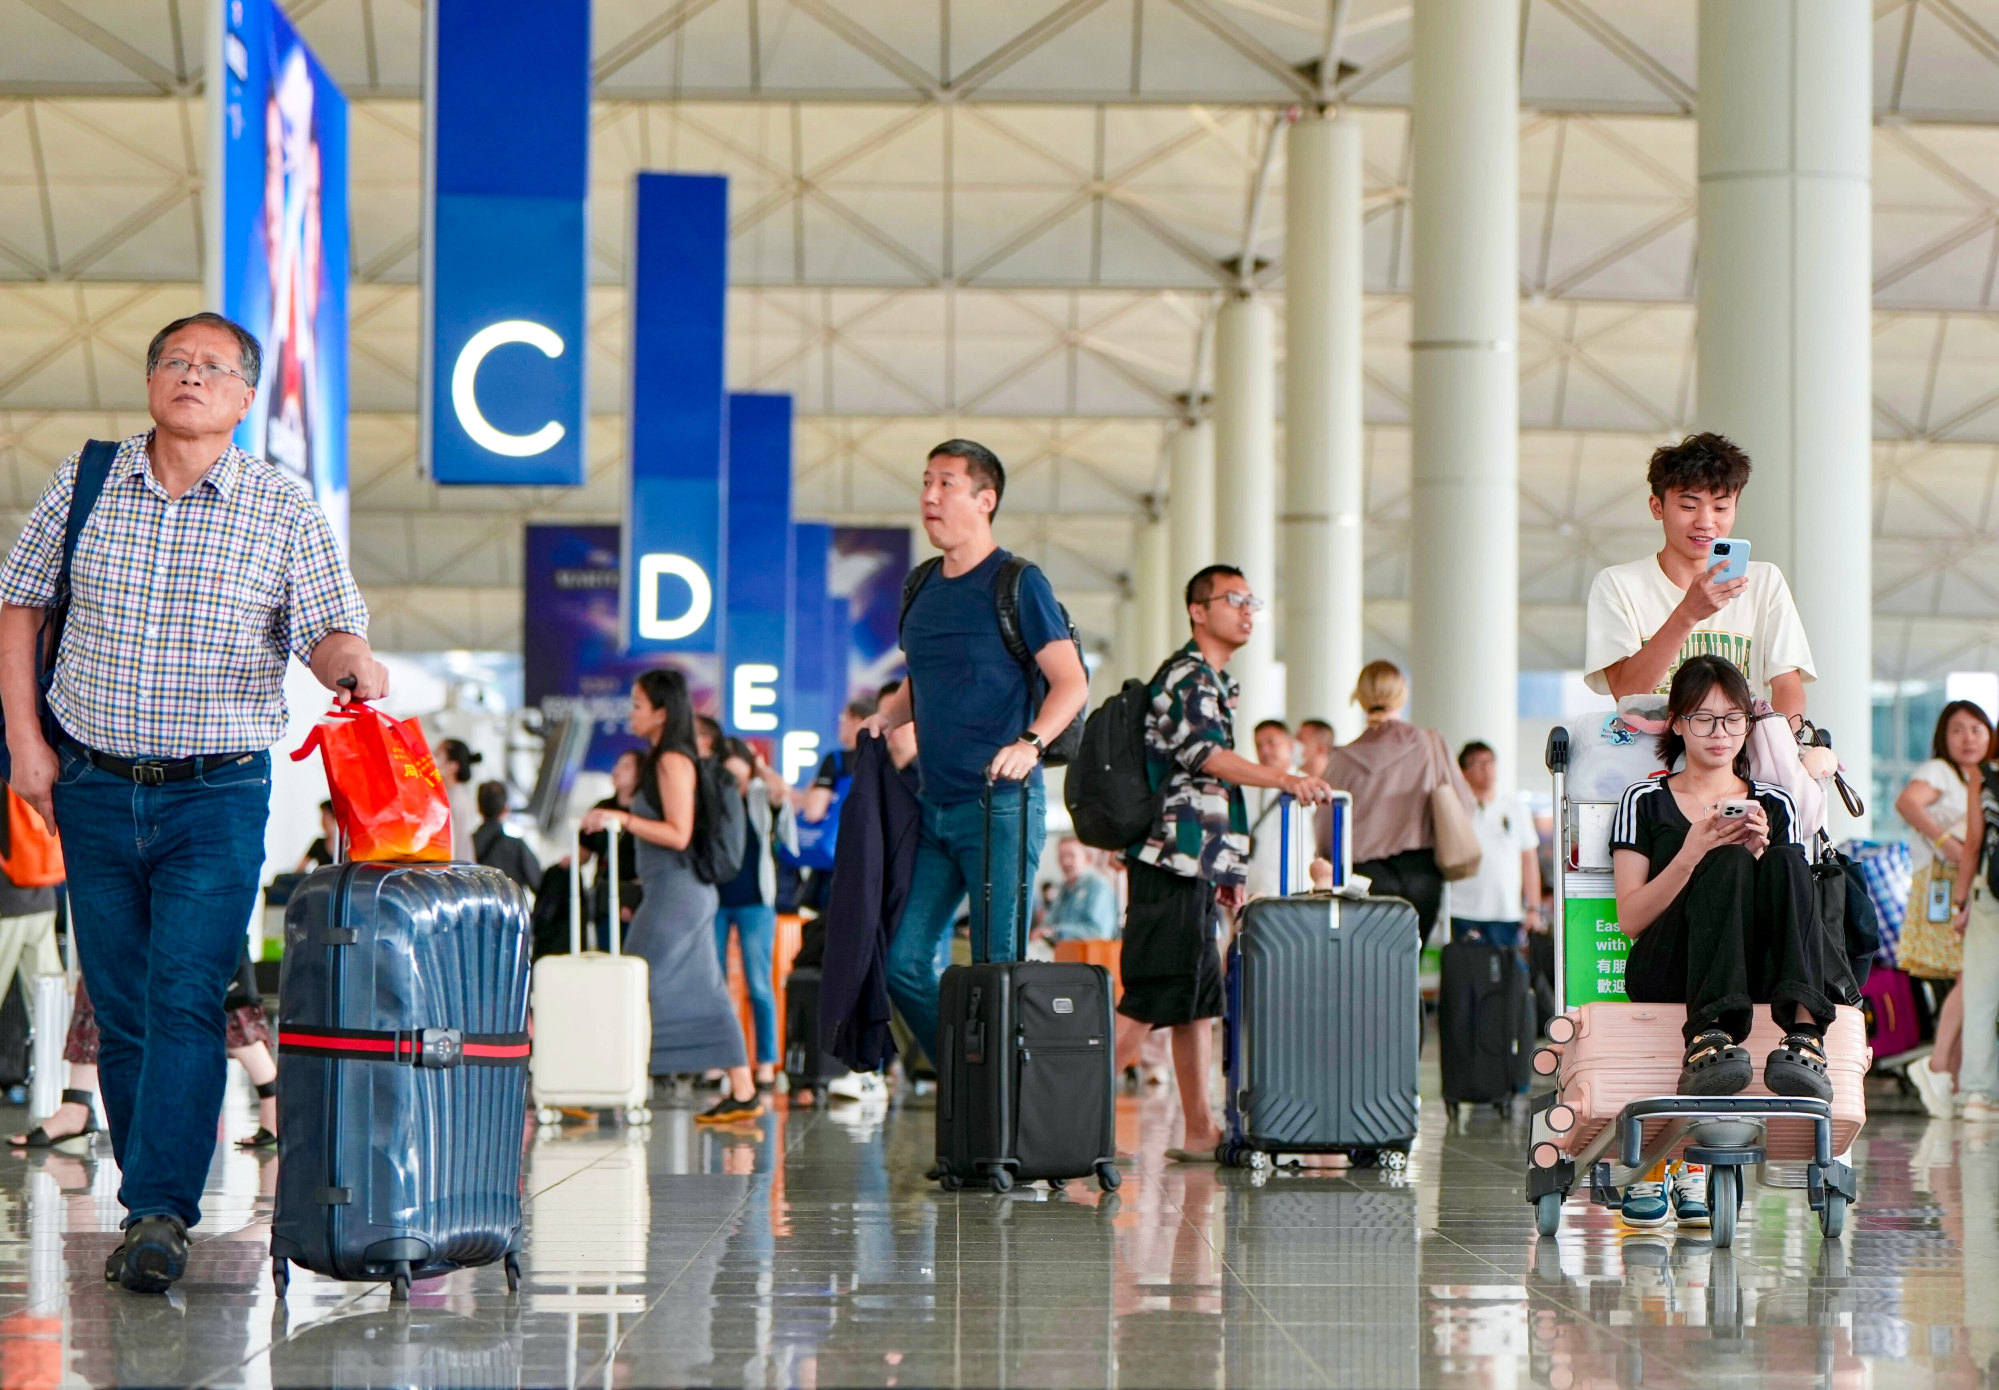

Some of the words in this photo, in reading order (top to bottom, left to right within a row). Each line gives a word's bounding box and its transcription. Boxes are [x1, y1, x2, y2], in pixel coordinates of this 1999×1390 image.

[451, 320, 565, 457] C
[638, 553, 712, 640] D
[733, 664, 779, 731] E
[782, 731, 820, 785] F
[1596, 919, 1625, 935] Eas
[1596, 938, 1626, 951] with
